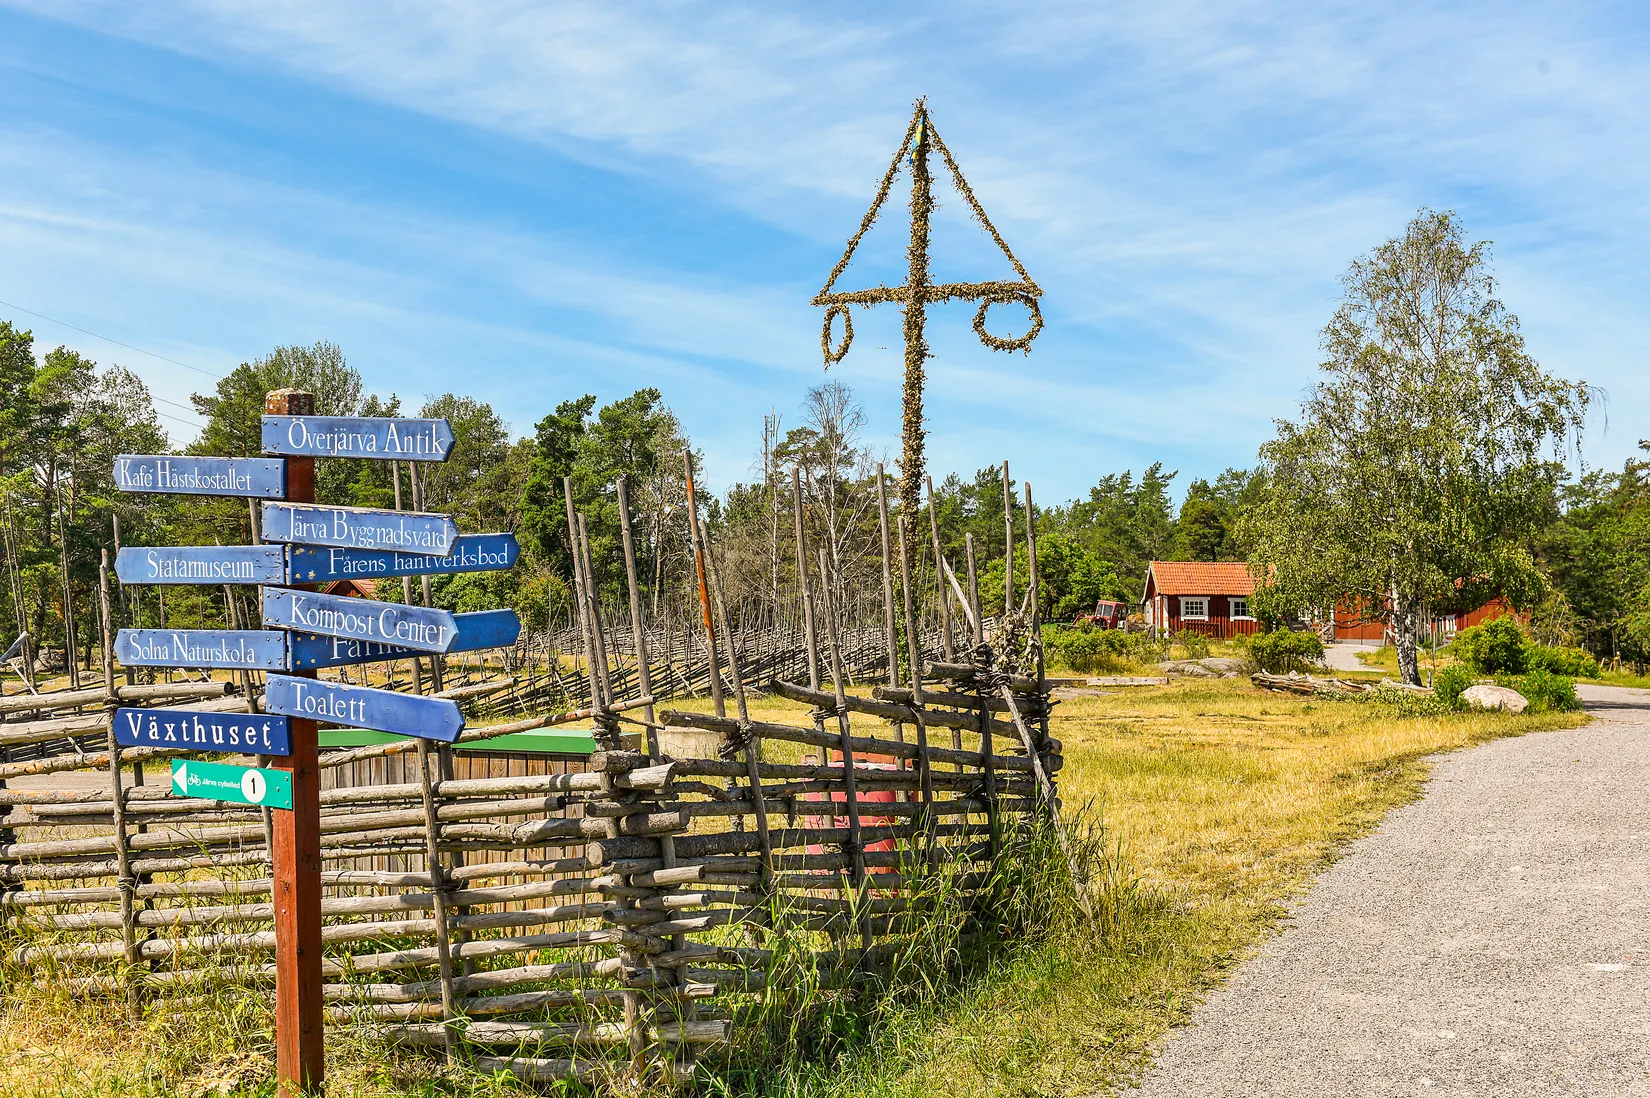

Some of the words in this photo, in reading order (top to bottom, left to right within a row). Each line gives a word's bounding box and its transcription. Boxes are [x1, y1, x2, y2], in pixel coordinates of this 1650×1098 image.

[288, 418, 377, 455] Överjärva
[383, 422, 446, 454] Antik
[120, 458, 153, 487] Kafé
[156, 460, 252, 490] Hästskostallet
[284, 507, 327, 542] Järva
[332, 509, 448, 549] Byggnadsvård
[147, 550, 254, 578] Statarmuseum
[328, 547, 387, 575] Fårens
[394, 543, 509, 571] hantverksbod
[290, 595, 375, 635] Kompost
[379, 608, 448, 646] Center
[130, 633, 169, 661] Solna
[171, 633, 256, 663] Naturskola
[290, 682, 366, 722] Toalett
[126, 712, 271, 747] Växthuset
[202, 777, 217, 787] Järva
[217, 780, 241, 789] cykelled
[250, 777, 256, 795] 1
